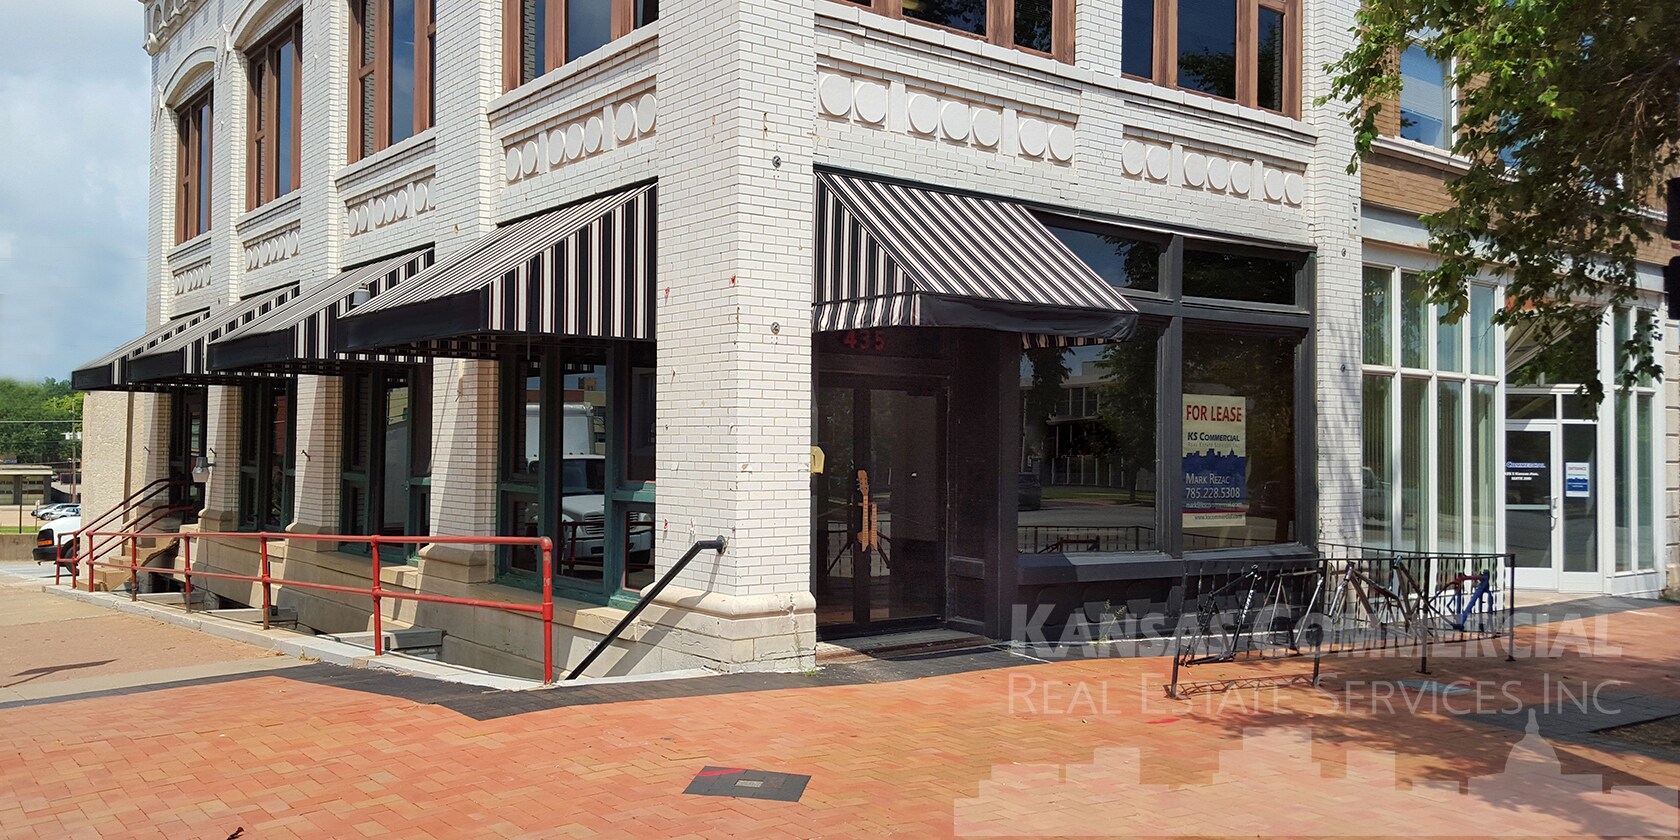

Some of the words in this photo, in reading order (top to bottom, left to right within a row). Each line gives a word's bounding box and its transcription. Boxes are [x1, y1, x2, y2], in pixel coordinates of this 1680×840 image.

[843, 330, 885, 352] 435
[1186, 405, 1208, 421] FOR
[1211, 406, 1242, 422] LEASE
[1187, 432, 1198, 441] KS
[1185, 487, 1240, 499] 785.228.5308
